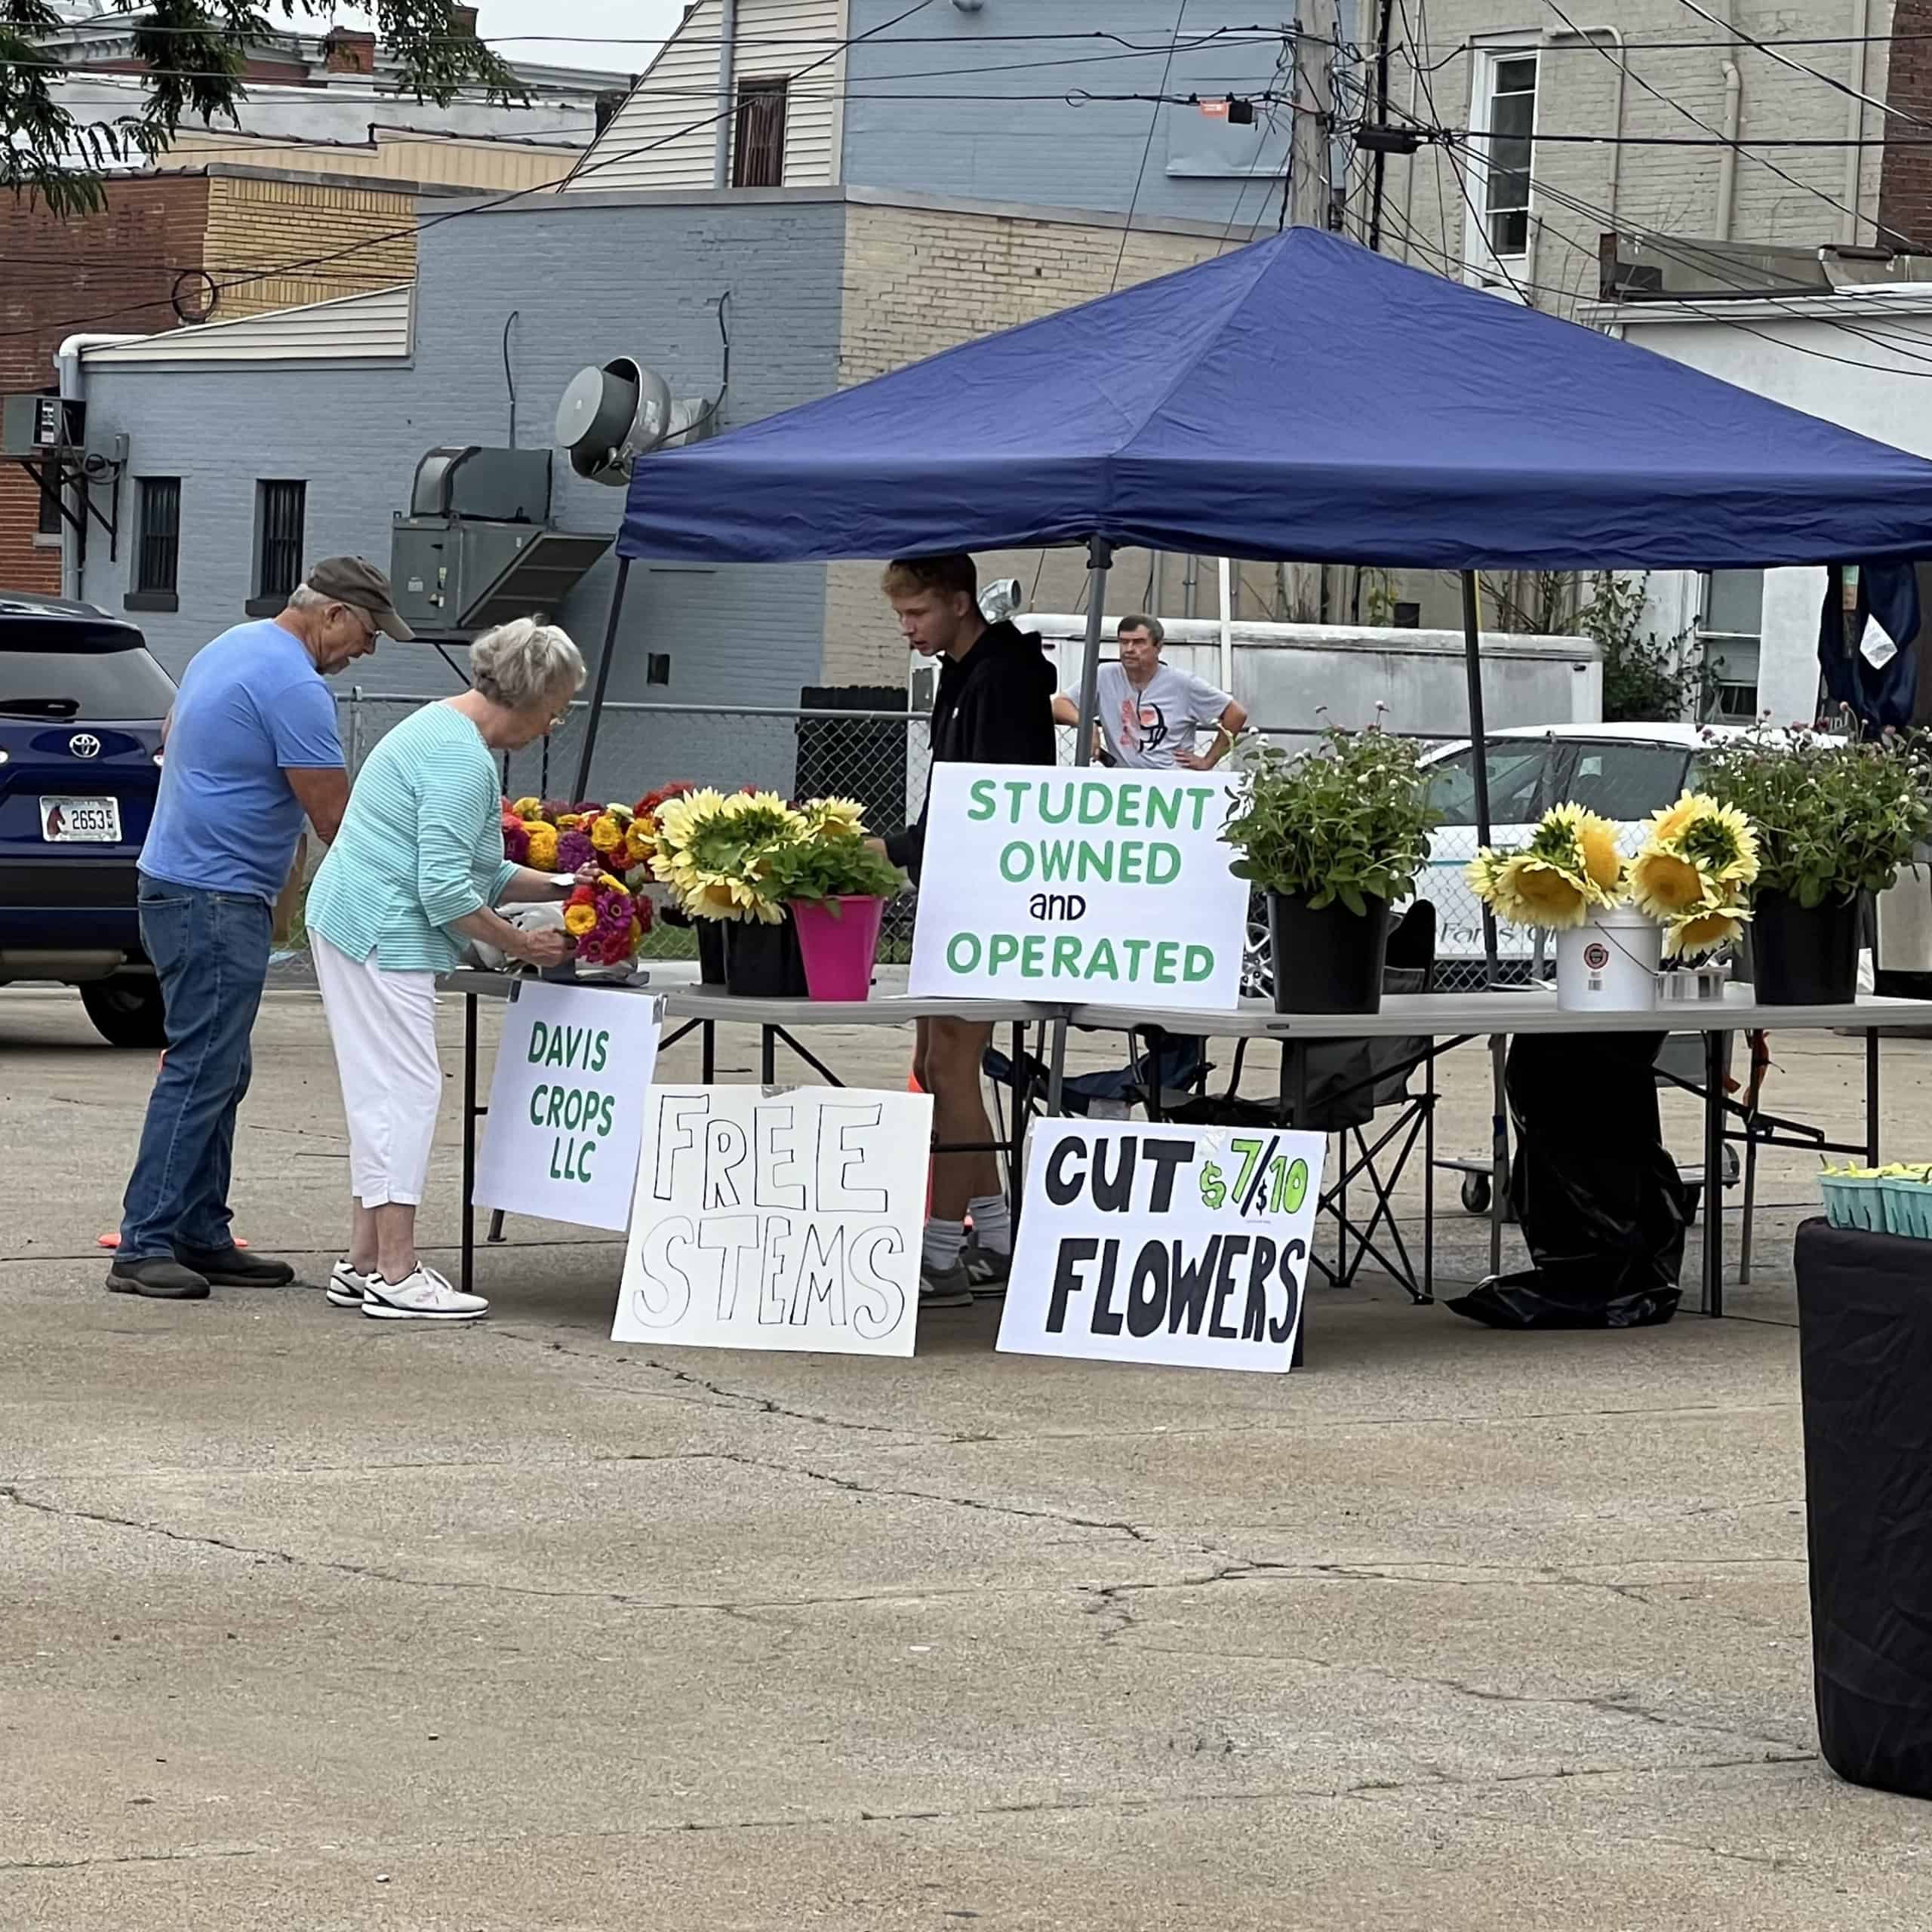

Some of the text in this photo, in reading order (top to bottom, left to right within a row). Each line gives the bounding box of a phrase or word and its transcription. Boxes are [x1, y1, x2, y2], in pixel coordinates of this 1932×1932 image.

[72, 810, 105, 829] 2653
[966, 778, 1216, 832] STUDENT
[998, 839, 1182, 885] OWNED
[1029, 893, 1087, 921] and
[946, 931, 1216, 985] OPERATED
[528, 1021, 611, 1073] DAVIS
[530, 1084, 616, 1137] CROPS
[549, 1136, 597, 1183] LLC
[654, 1094, 888, 1214] FREE
[1044, 1135, 1196, 1213] CUT
[632, 1214, 905, 1340] STEMS
[1045, 1234, 1306, 1344] FLOWERS
